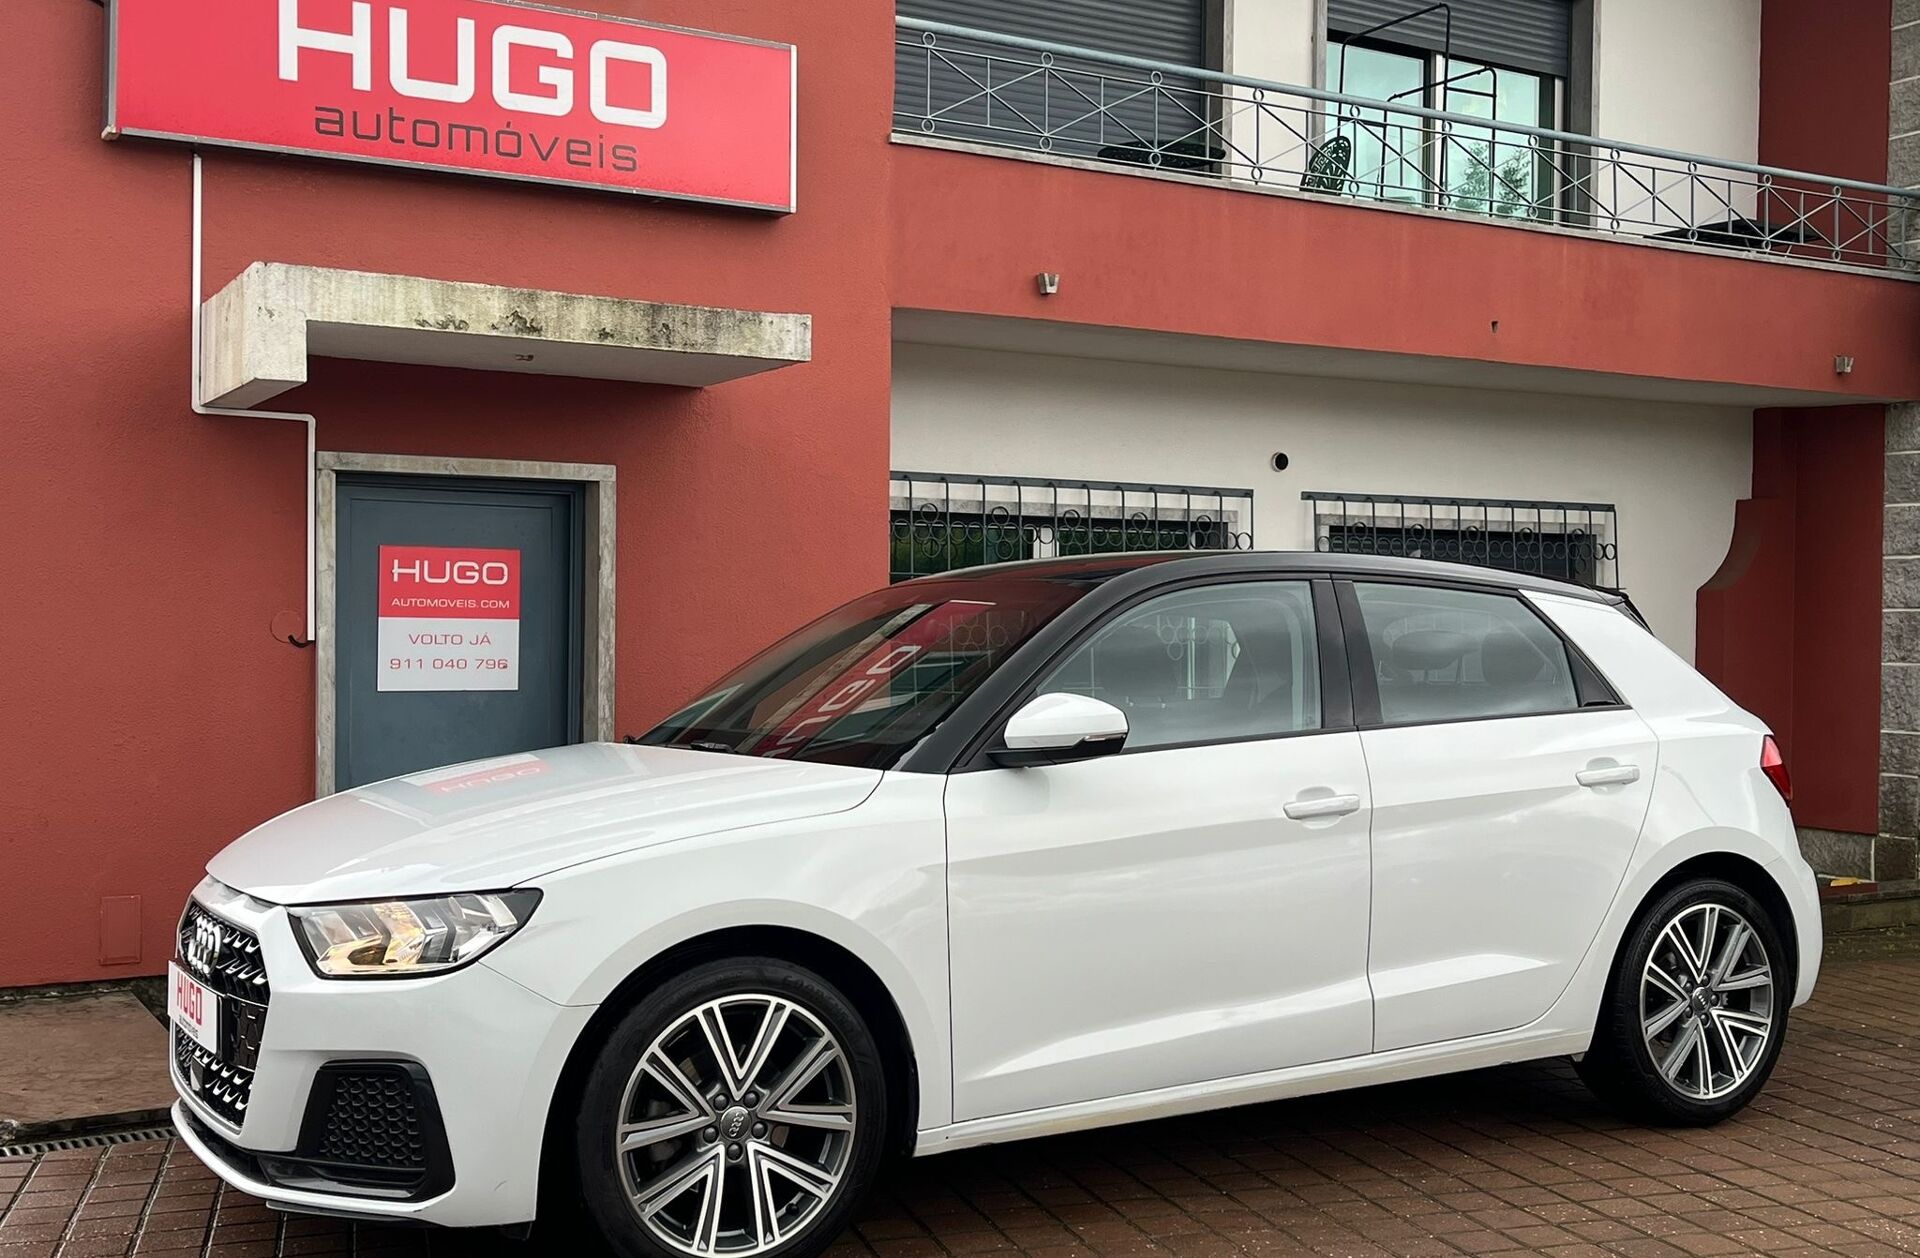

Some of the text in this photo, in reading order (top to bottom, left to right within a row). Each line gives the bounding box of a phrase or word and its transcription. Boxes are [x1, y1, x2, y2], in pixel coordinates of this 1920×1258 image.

[278, 0, 668, 129] HUGO
[314, 105, 639, 173] automóveis
[392, 559, 509, 585] HUGO
[391, 598, 510, 609] AUTOMOVEIS.COM
[408, 631, 492, 646] VOLTO JÁ
[390, 658, 508, 670] 911 040 796
[176, 971, 204, 1026] HUGO
